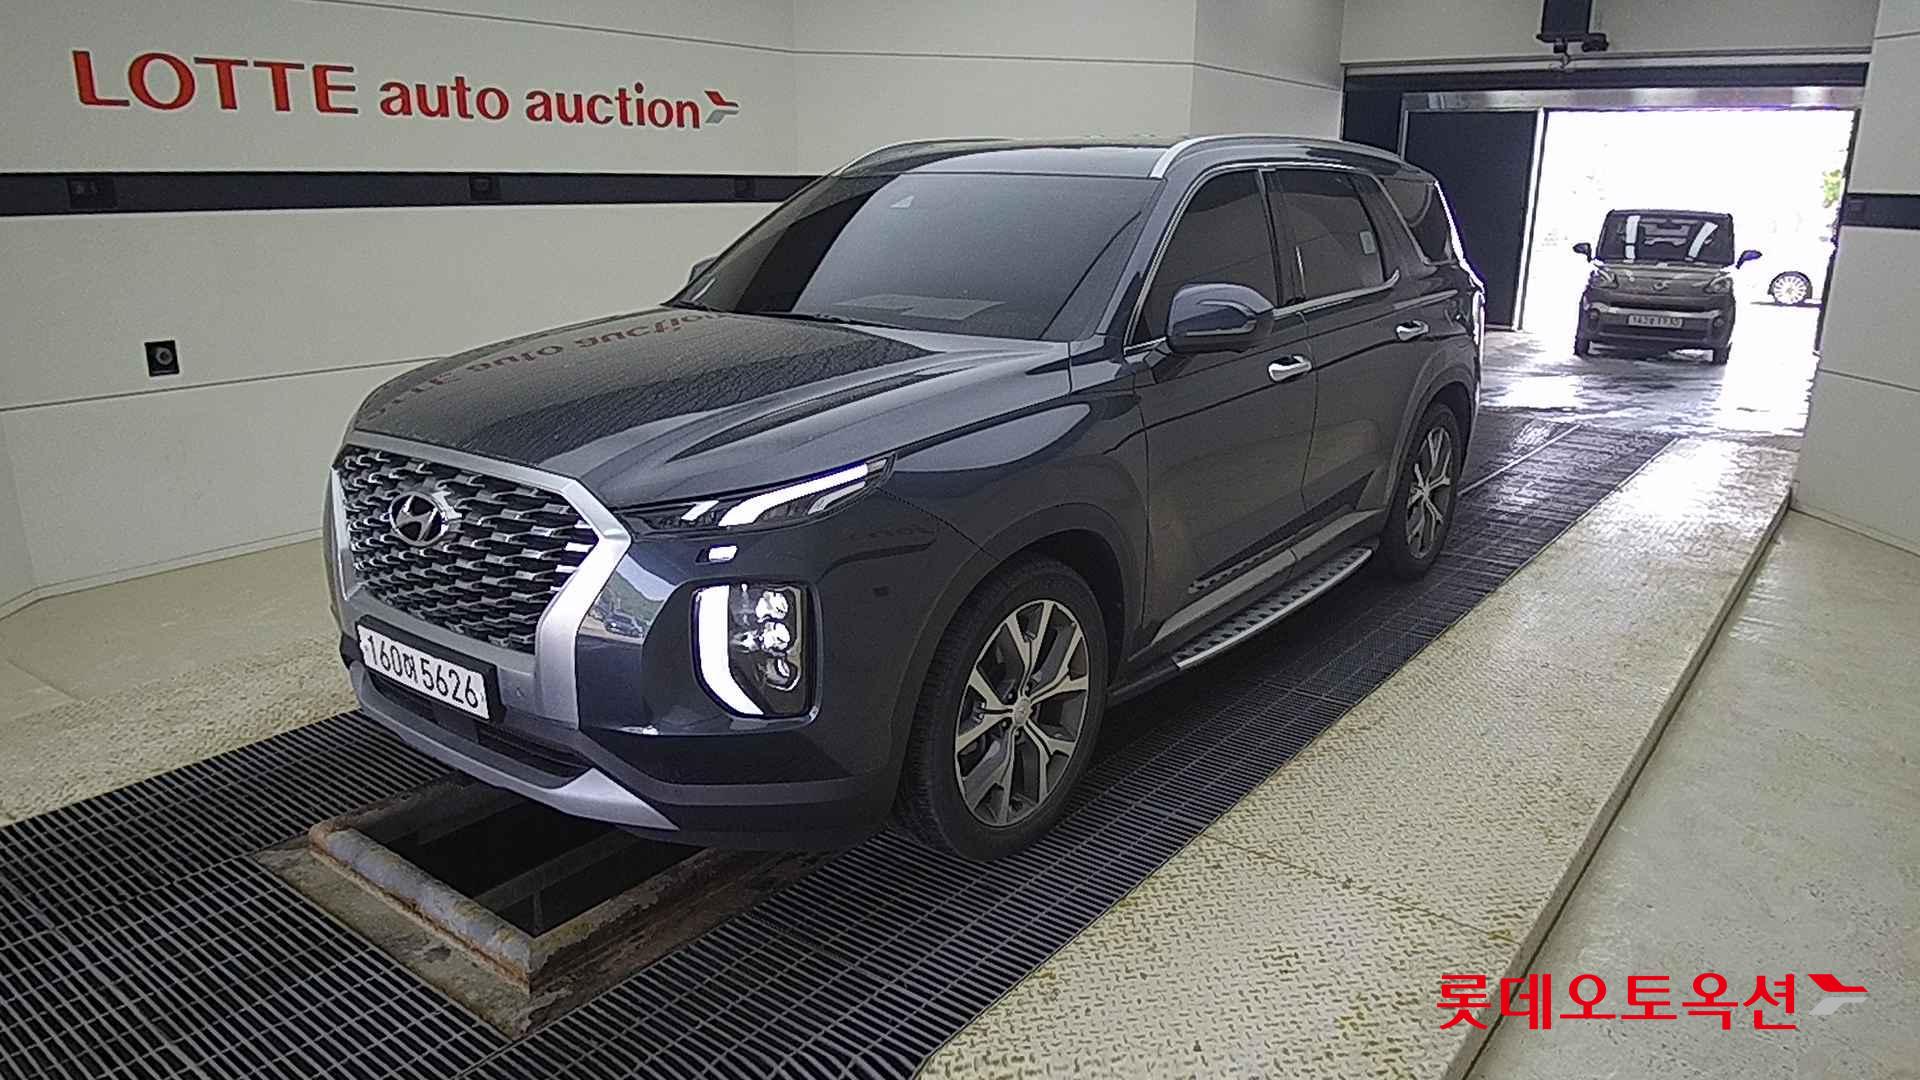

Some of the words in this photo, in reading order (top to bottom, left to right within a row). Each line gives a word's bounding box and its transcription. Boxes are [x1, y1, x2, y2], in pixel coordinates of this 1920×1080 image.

[72, 50, 359, 114] LOTTE
[379, 76, 509, 121] auto
[525, 82, 701, 129] auction
